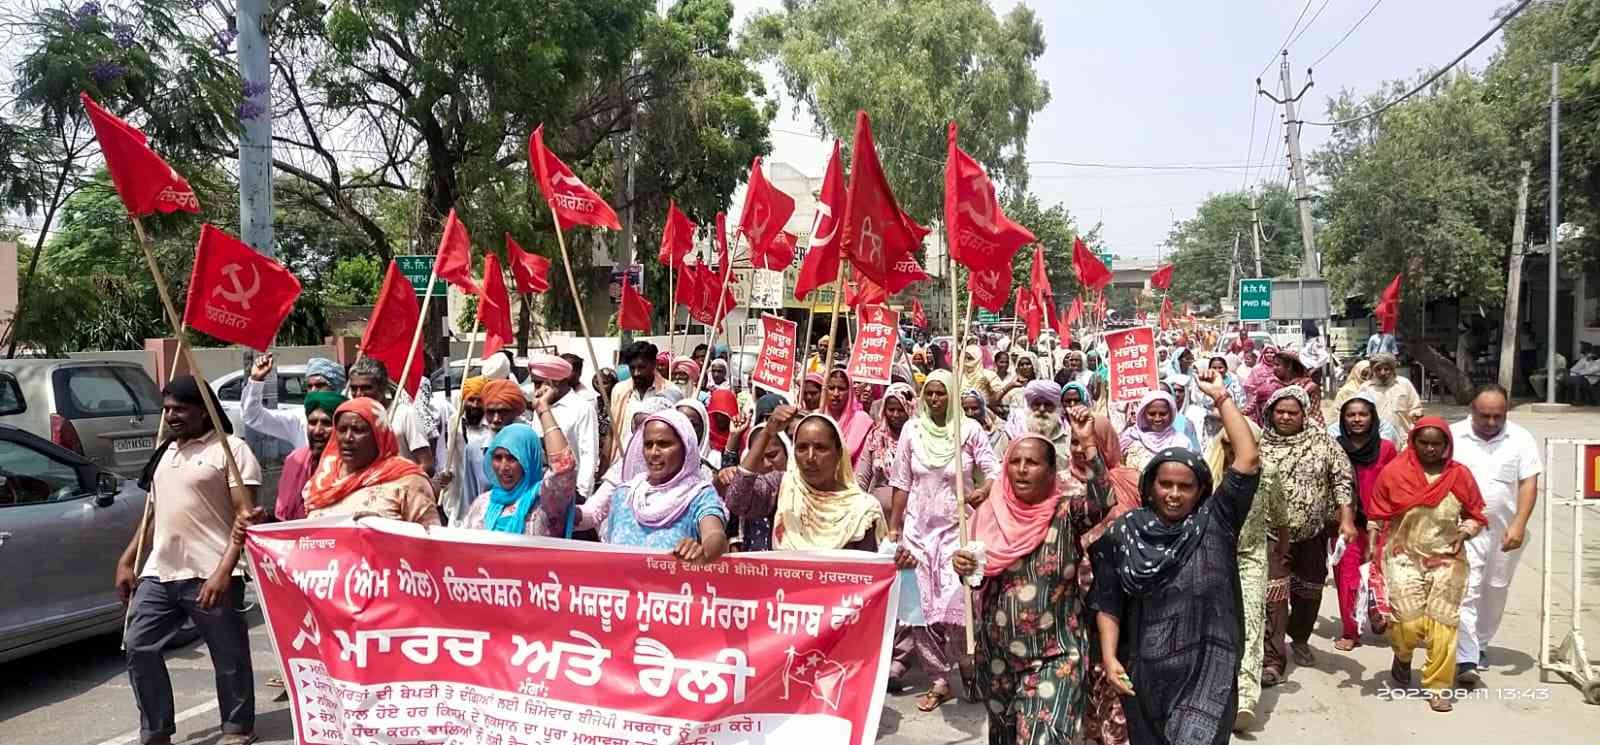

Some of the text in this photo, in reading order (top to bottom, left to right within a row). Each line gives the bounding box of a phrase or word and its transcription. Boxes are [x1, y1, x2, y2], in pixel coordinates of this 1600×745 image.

[735, 562, 769, 578] ਬੀਜੇਪੀ
[774, 567, 814, 581] ਸਰਕਾਰ
[818, 571, 875, 586] ਮੁਰਦਾਬਾਦ
[443, 566, 524, 608] ਲਿਬਰੇਸ਼ਨ
[527, 571, 563, 613] ਅਤੇ
[635, 582, 694, 633] ਮੁਕਤੀ
[700, 582, 759, 631] ਮੋਰਚਾ
[766, 588, 824, 638] ਪੰਜਾਬ
[332, 628, 756, 704] ਮਾਰਚ ਅਤੇ ਰੈਲੀ
[375, 685, 392, 700] ਦੀ
[400, 684, 439, 699] ਬੇਪਤੀ
[444, 685, 455, 700] ਤੇ
[497, 696, 520, 711] ਲਈ
[578, 709, 617, 730] ਬੀਜੇਪੀ
[623, 719, 673, 736] ਸਰਕਾਰ
[406, 706, 428, 719] ਹਰ
[471, 707, 481, 723] ਦੇ
[524, 723, 538, 736] ਦਾ
[387, 726, 417, 742] ਕਰਨ
